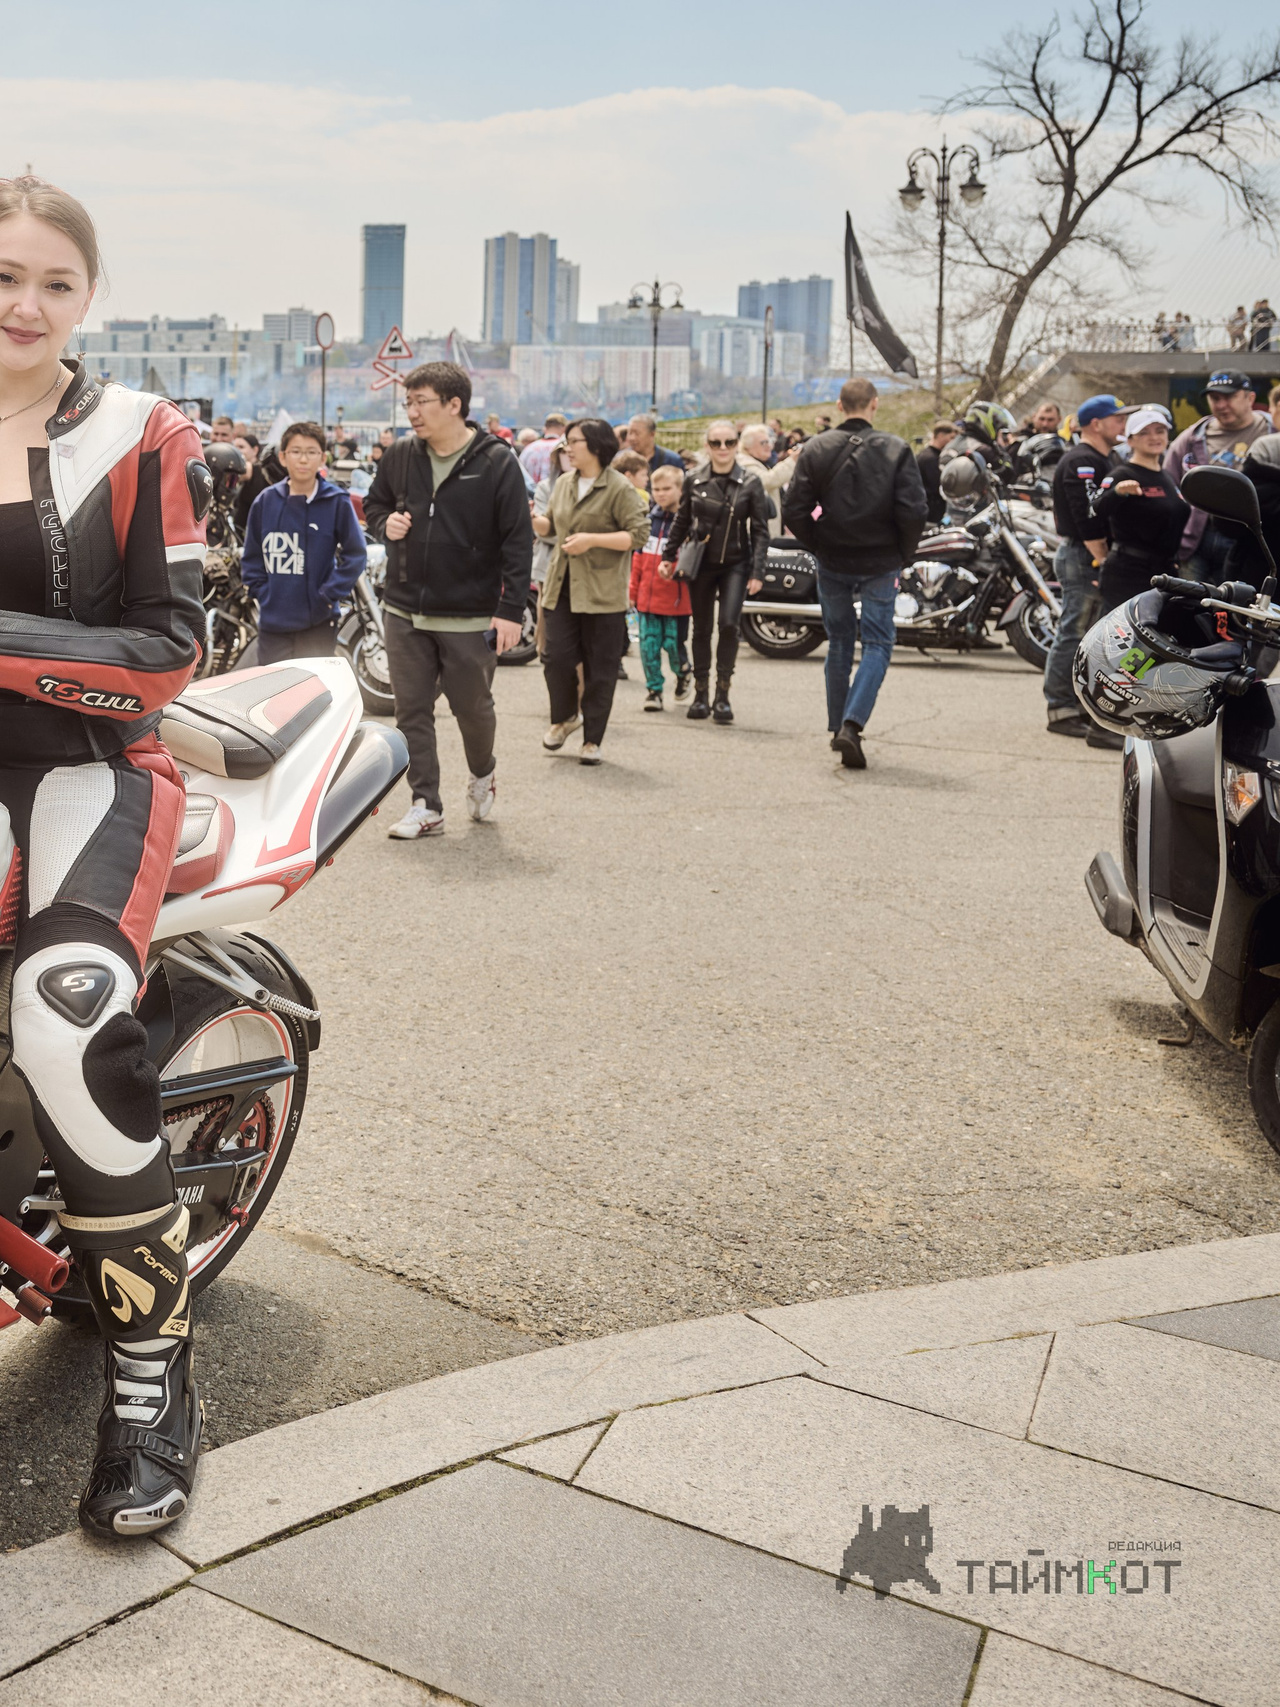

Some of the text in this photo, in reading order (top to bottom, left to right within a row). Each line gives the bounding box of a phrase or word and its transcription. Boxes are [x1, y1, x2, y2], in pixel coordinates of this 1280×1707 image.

[40, 678, 141, 712] TSCHUL
[1095, 670, 1140, 705] Kawasaki
[177, 1184, 206, 1205] MAHA
